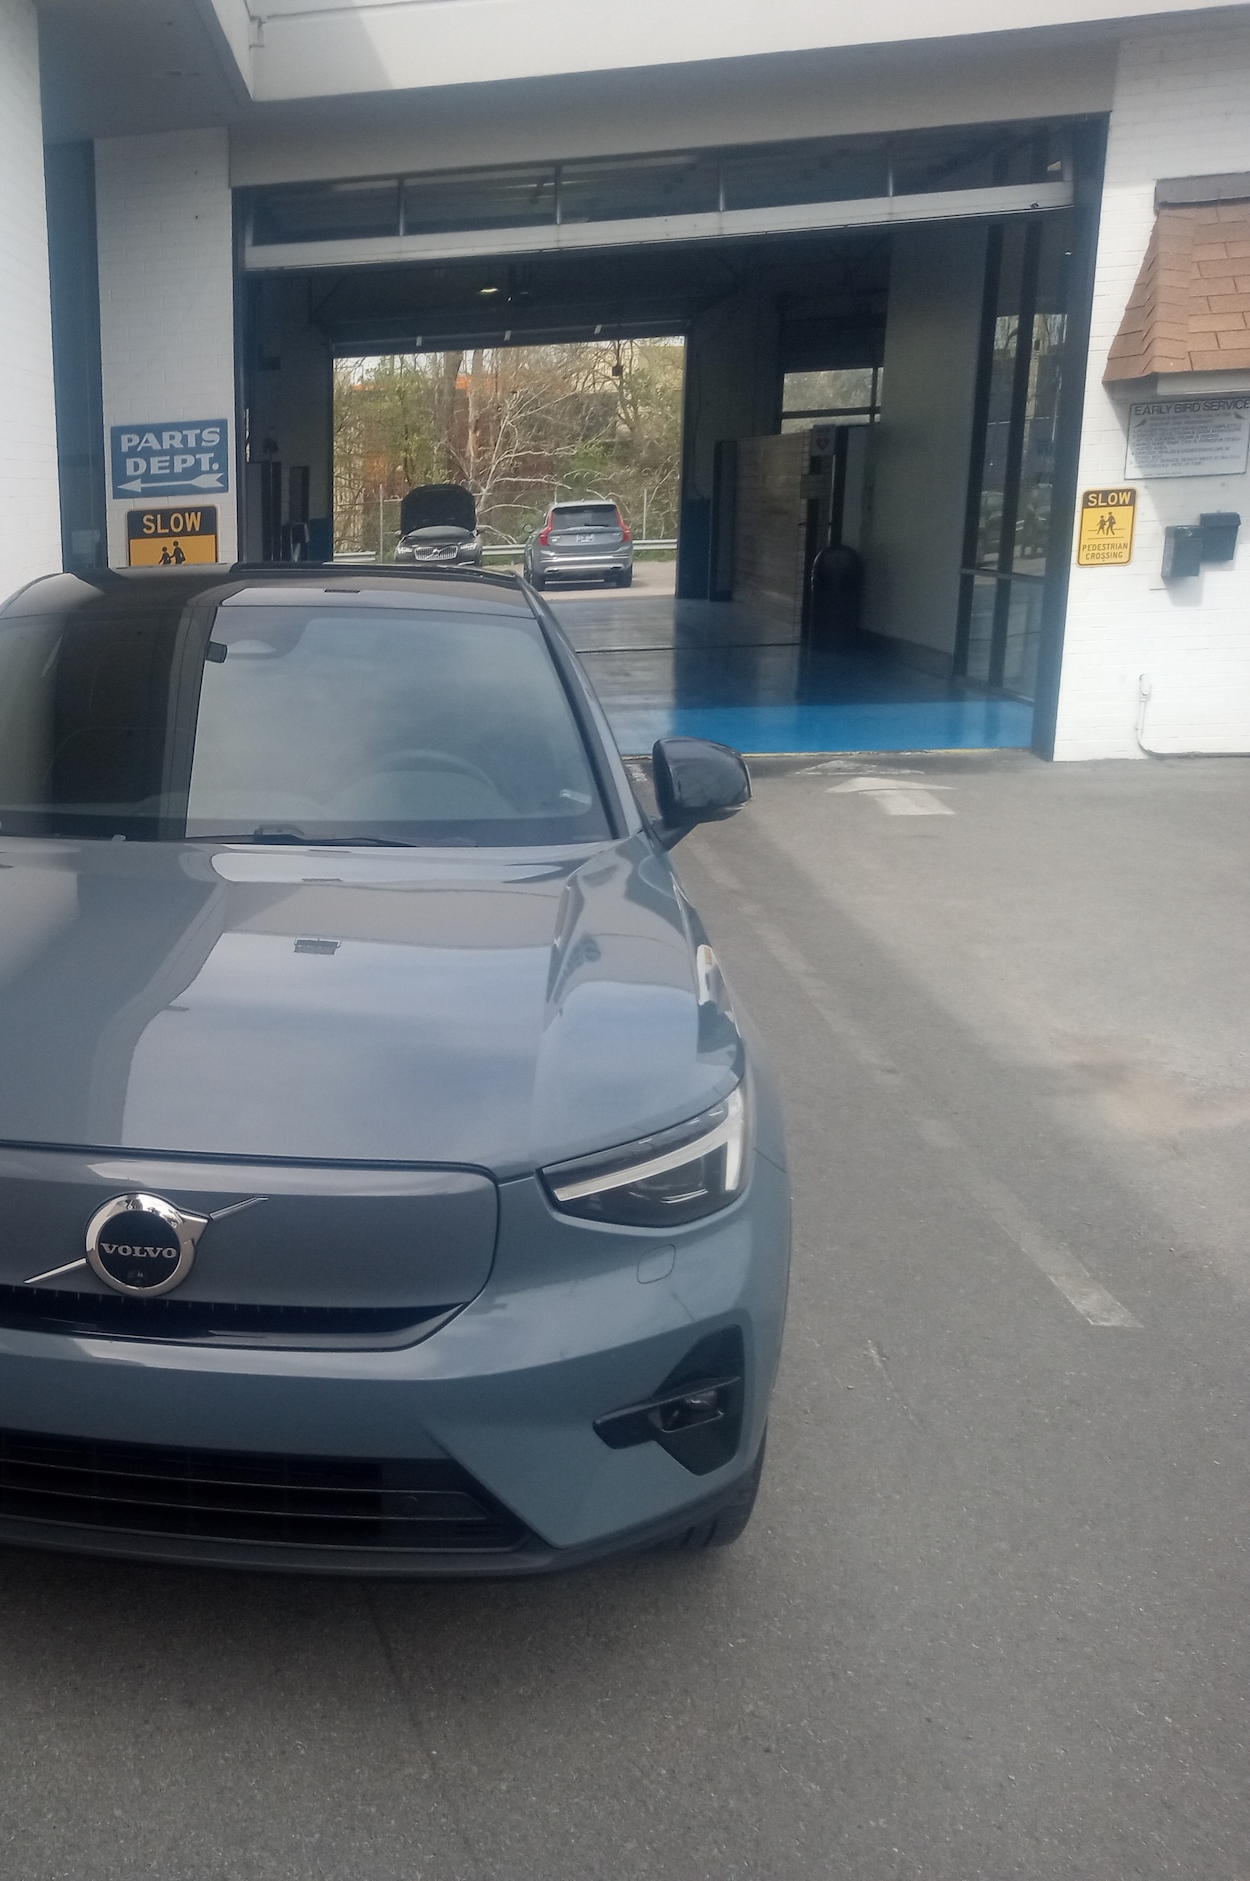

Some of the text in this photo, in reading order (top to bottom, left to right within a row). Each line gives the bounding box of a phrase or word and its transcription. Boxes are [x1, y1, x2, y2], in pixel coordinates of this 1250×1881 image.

[1134, 404, 1172, 416] EARLY
[1174, 402, 1200, 414] BIRD
[1202, 399, 1250, 411] SERVICE
[120, 427, 220, 452] PARTS
[126, 453, 219, 476] DEPT.
[1088, 491, 1131, 506] SLOW
[142, 511, 202, 534] SLOW
[1082, 542, 1128, 551] PEDESTRIAN
[1085, 551, 1123, 560] CROSSING
[100, 1242, 177, 1259] VOLVO
